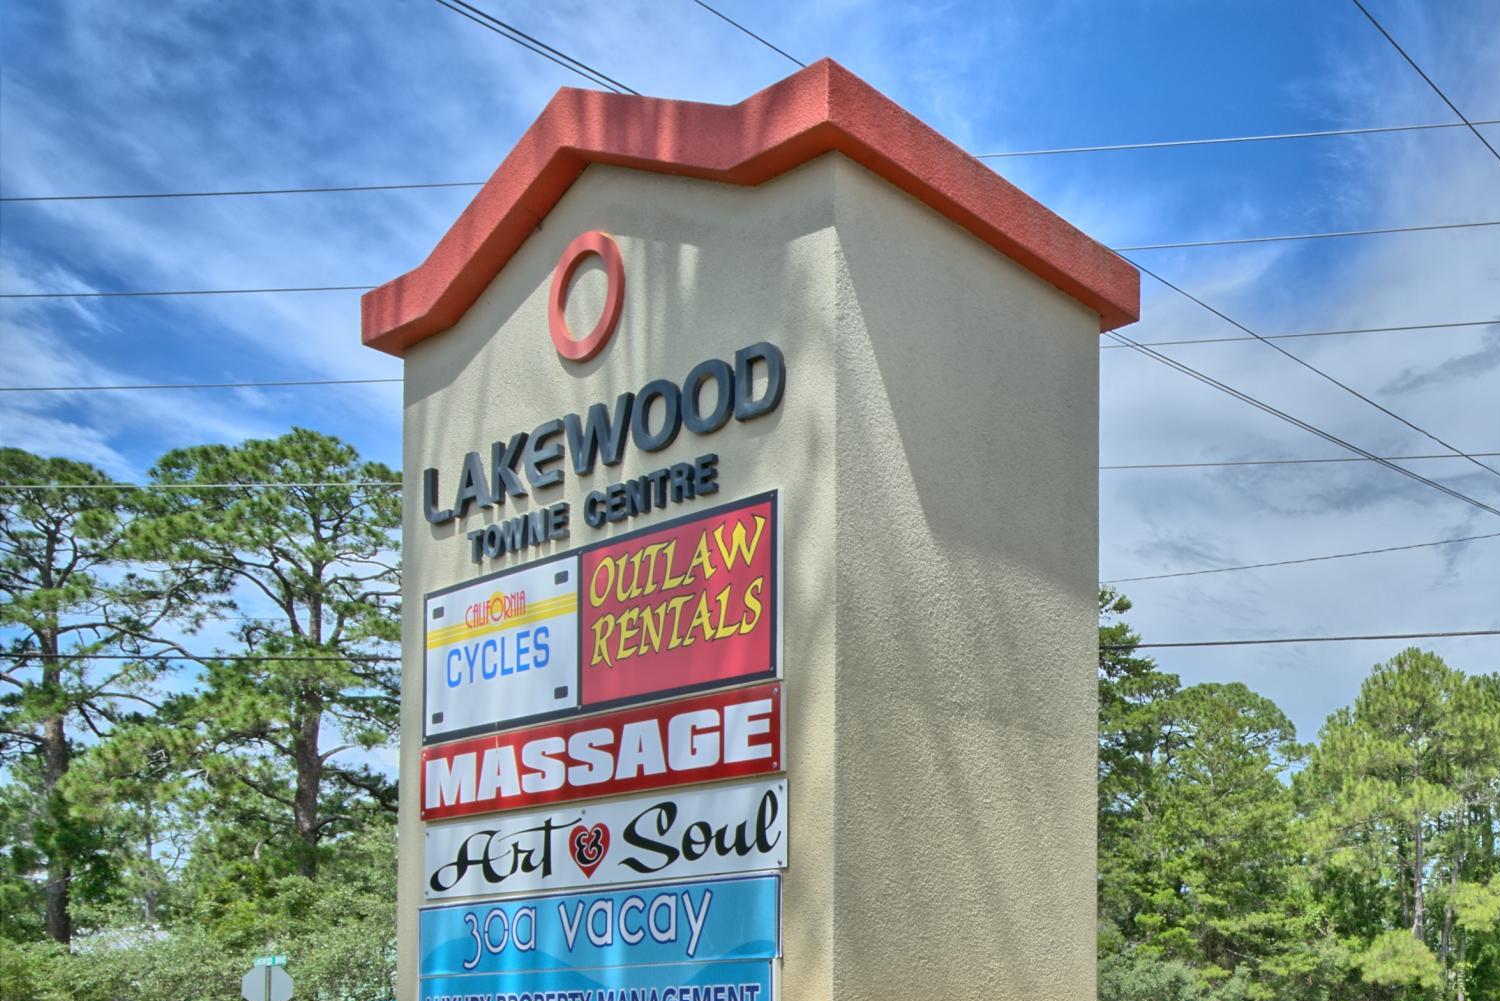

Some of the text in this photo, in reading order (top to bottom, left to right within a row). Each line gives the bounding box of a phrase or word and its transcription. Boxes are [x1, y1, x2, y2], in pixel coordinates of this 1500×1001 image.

[423, 342, 786, 525] LAKEWOOD
[467, 453, 719, 564] TOWNE CENTRE
[588, 513, 767, 608] OUTLAW
[446, 626, 551, 688] CYCLES
[464, 590, 526, 629] CALIFORNIA
[589, 577, 763, 669] RENTALS
[425, 698, 773, 810] MASSAGE
[430, 817, 582, 892] Art
[618, 789, 782, 873] Soul
[463, 888, 712, 970] 30a vacay
